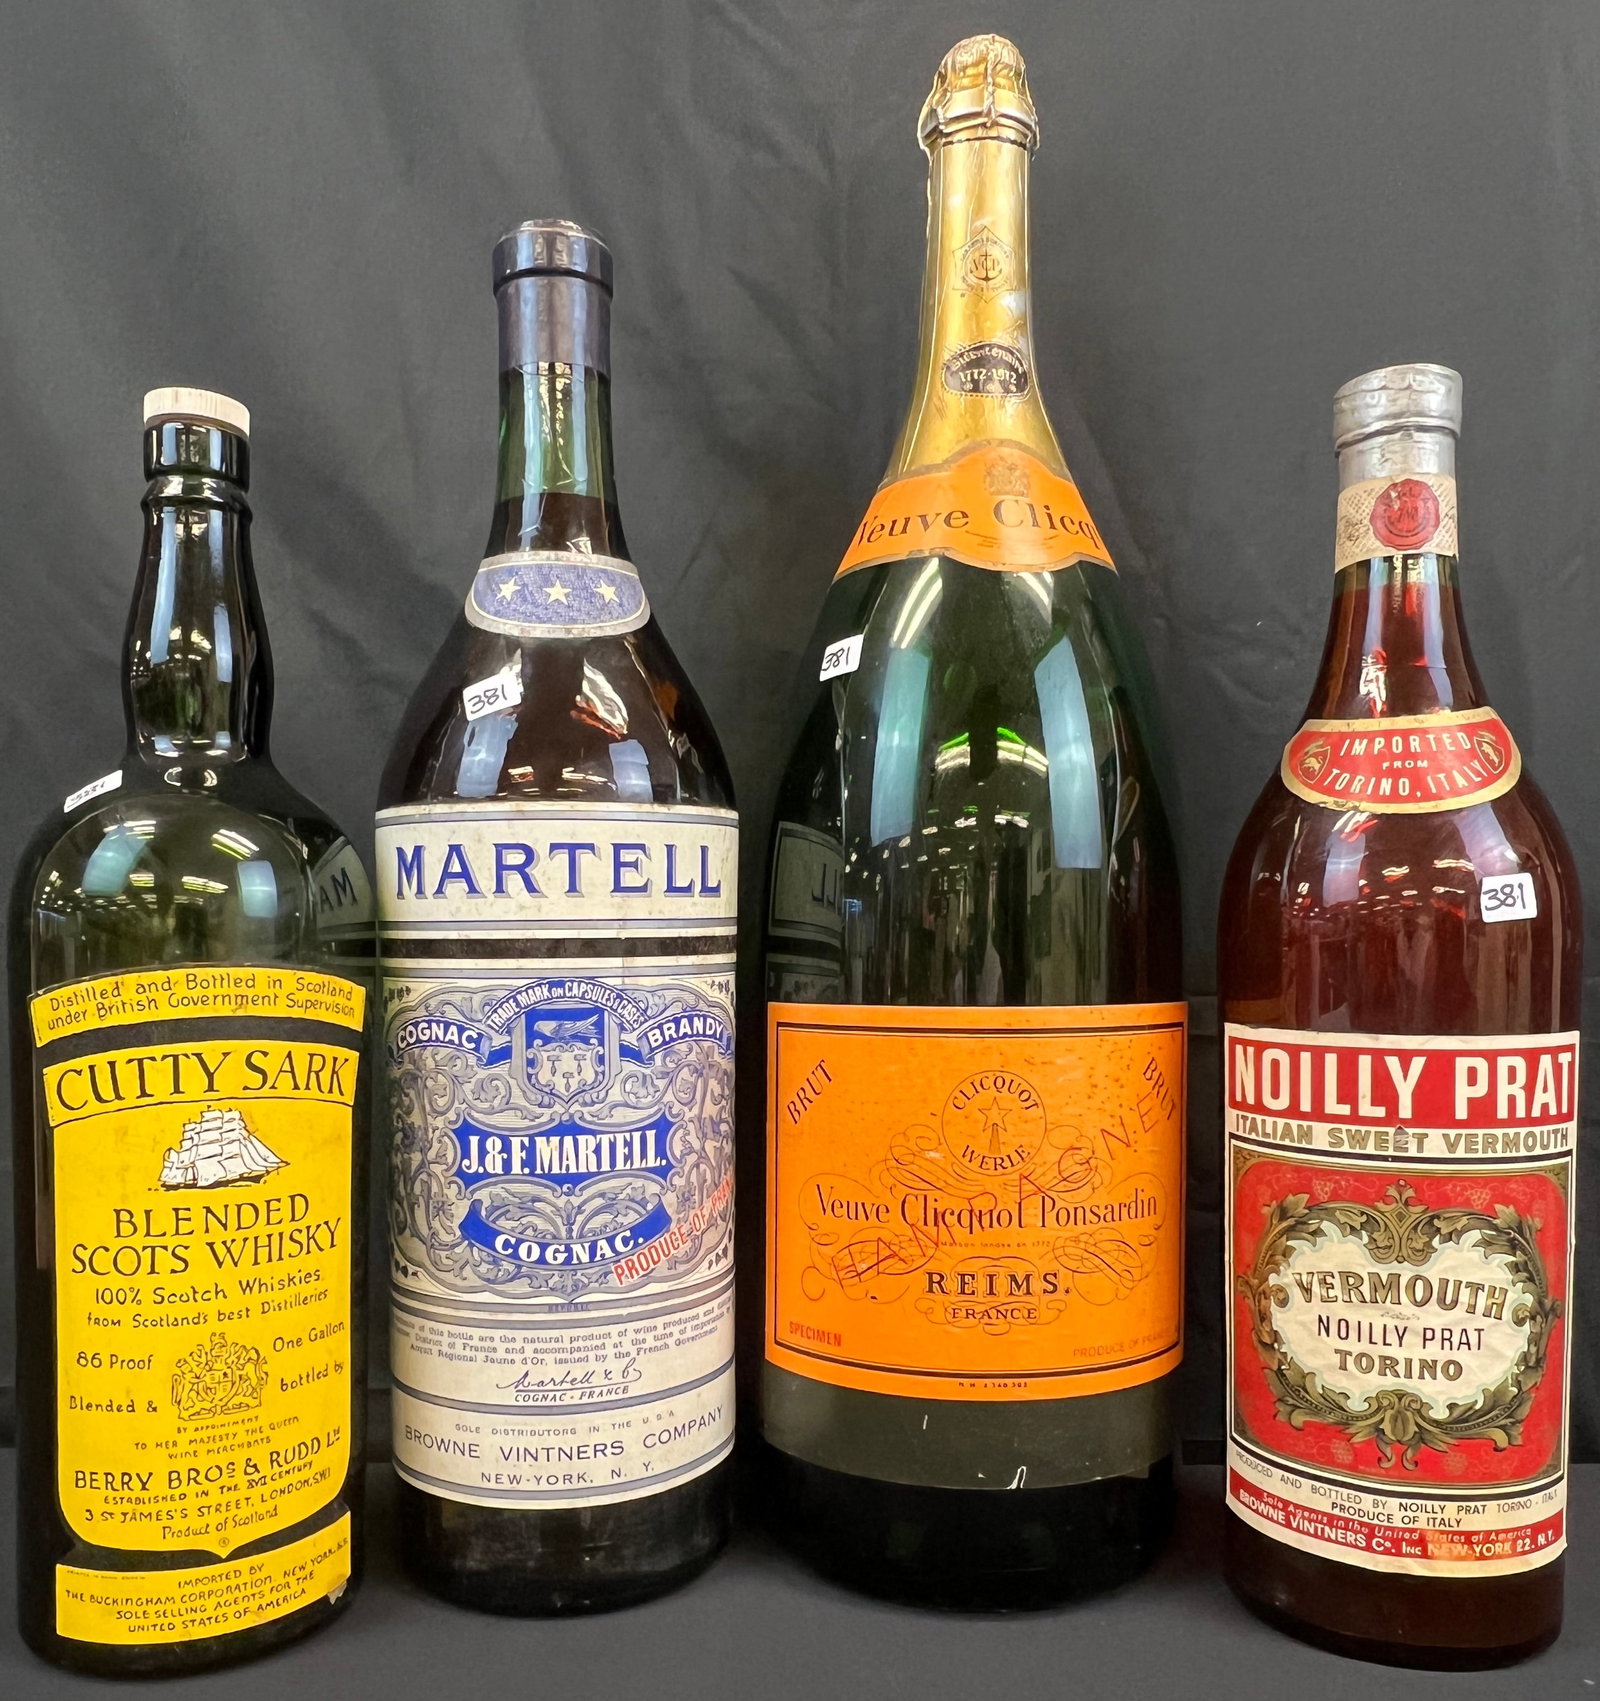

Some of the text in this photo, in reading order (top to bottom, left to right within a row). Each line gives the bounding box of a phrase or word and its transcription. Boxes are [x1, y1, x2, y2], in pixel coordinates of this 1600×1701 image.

[821, 646, 851, 672] 381
[468, 684, 508, 715] 381
[1340, 731, 1472, 757] IMPORTED
[1323, 759, 1488, 798] TORINO, ITALY
[1382, 760, 1429, 770] FROM
[395, 842, 723, 900] MARTELL
[1482, 882, 1526, 911] 381
[48, 992, 355, 1030] under British Government Supervision
[50, 973, 353, 1012] Distilled and Bottled in Scotland
[487, 981, 644, 1031] TRADE MARK ON CAPSULES CASES
[397, 1018, 724, 1050] COGNAC BRANDY
[56, 1050, 350, 1111] CUTTY SARK
[786, 1059, 833, 1125] BRUT
[952, 1075, 1039, 1111] CLICQUOT
[1142, 1057, 1176, 1120] BRUT
[1235, 1044, 1572, 1120] NOILLY PRAT
[1235, 1113, 1568, 1155] ITALIAN SWEET VERMOUTH
[961, 1144, 1031, 1171] WERLE
[113, 1193, 310, 1239] BLENDED
[816, 1183, 1157, 1235] Veuve Clicquot Ponsardin
[71, 1217, 342, 1276] SCOTS WHISKY
[494, 1231, 645, 1264] COGNAC.
[613, 1205, 708, 1285] PRODUCE OF
[94, 1267, 322, 1305] 100% Scotch Whiskies
[925, 1271, 1072, 1296] REIMS.
[1292, 1271, 1509, 1321] VERMOUTH
[132, 1288, 329, 1329] Scotland's best Distilleries
[951, 1307, 1037, 1320] FRANCE
[272, 1320, 345, 1353] One Gallon
[462, 1343, 498, 1354] France
[505, 1346, 525, 1354] and
[532, 1343, 606, 1356] accompanied
[499, 1335, 517, 1344] the
[522, 1335, 565, 1344] natural
[569, 1332, 613, 1344] product
[633, 1325, 658, 1335] wine
[636, 1343, 669, 1356] French
[789, 1321, 842, 1347] SPECIMEN
[1317, 1314, 1485, 1351] NOILLY PRAT
[76, 1352, 154, 1371] 86 Proof
[280, 1360, 345, 1393] bottled by
[1334, 1348, 1463, 1382] TORINO
[68, 1395, 158, 1413] Blended &
[514, 1385, 630, 1403] COGNAC FRANCE
[405, 1404, 725, 1463] BROWNE VINTNERS COMPANY
[455, 1423, 480, 1433] SOLE
[588, 1425, 600, 1434] IN
[611, 1420, 632, 1431] THE
[74, 1470, 154, 1492] BERRY
[243, 1457, 261, 1477] &
[269, 1436, 321, 1470] RUDD
[103, 1460, 313, 1506] ESTABLISHED IN THE CENTURY
[1280, 1474, 1302, 1489] AND
[1311, 1484, 1362, 1505] BOTTLED
[1372, 1499, 1388, 1510] BY
[1398, 1502, 1446, 1515] NOILLY
[1457, 1504, 1488, 1515] PRAT
[85, 1509, 94, 1521] 3
[119, 1508, 188, 1523] JAMES'S
[162, 1504, 279, 1541] Product of Scotland
[1263, 1492, 1532, 1543] Sole Agents in the United States of America
[1289, 1514, 1367, 1548] VINTNERS
[1331, 1502, 1462, 1528] PRODUCE OF ITALY
[65, 1562, 308, 1607] THE BUCKINGHAM CORPORATION NEW
[178, 1563, 265, 1589] IMPORTED BY
[116, 1570, 315, 1620] SOLE SELLING AGENTS FOR THE
[128, 1588, 308, 1633] UNITED STATES OF AMERICA
